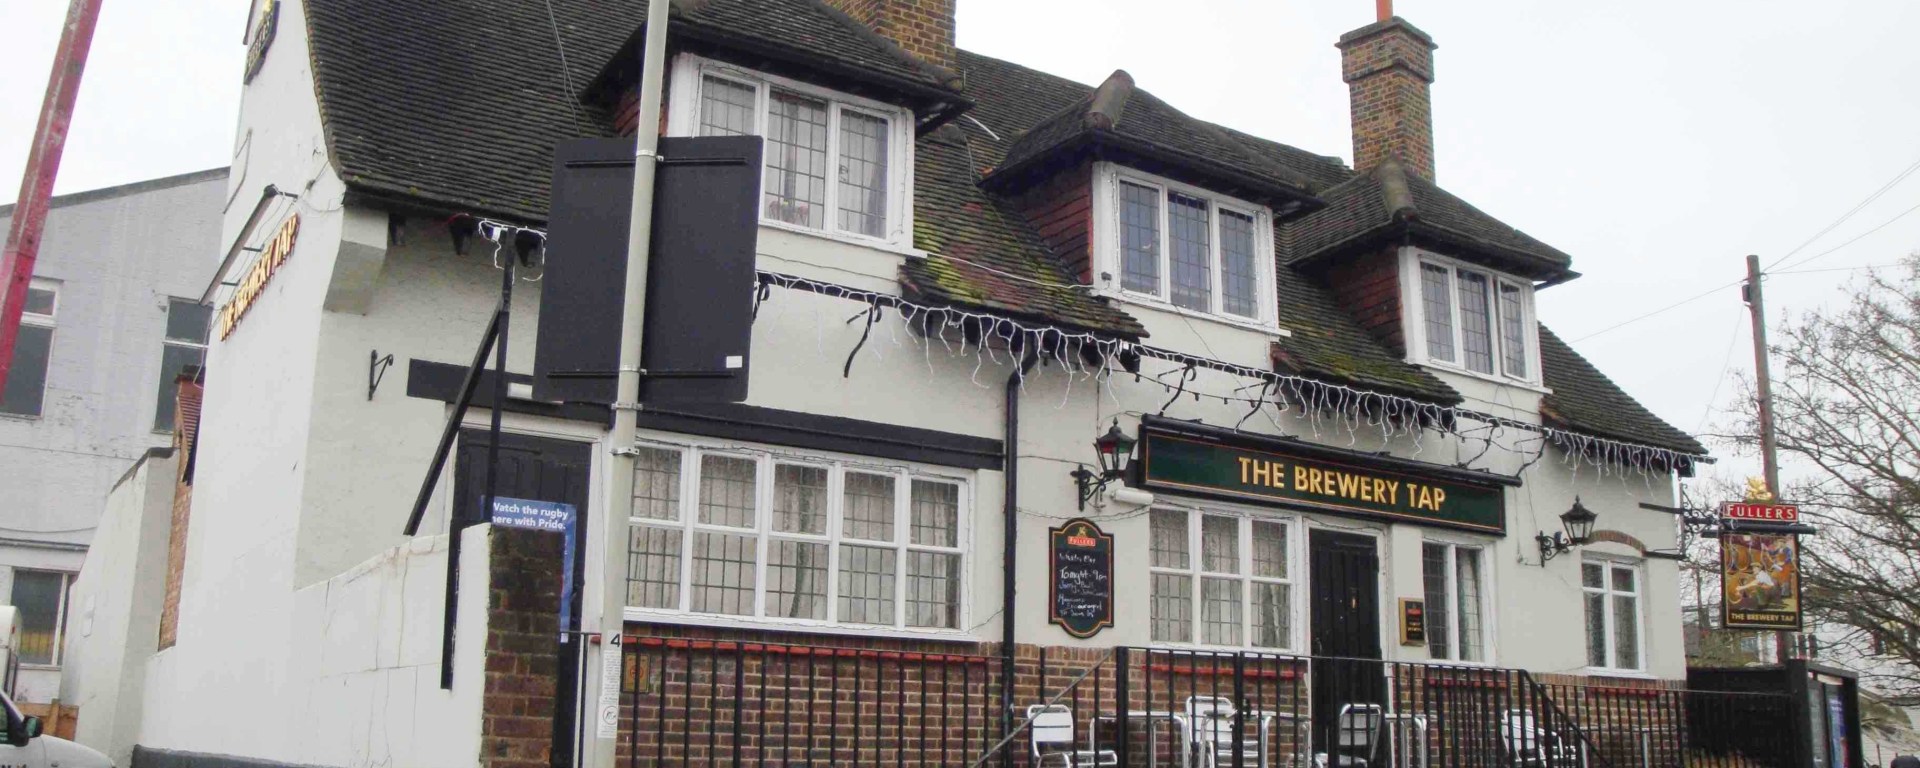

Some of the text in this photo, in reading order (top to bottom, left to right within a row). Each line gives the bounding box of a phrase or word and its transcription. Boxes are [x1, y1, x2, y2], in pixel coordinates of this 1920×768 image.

[1238, 456, 1446, 512] THE BREWERY TAP
[521, 505, 539, 515] the
[540, 508, 569, 521] rugby
[514, 517, 536, 527] with
[538, 518, 567, 530] Pride.
[1731, 613, 1745, 621] THE
[1746, 613, 1780, 622] BREWERY
[610, 633, 621, 648] 4
